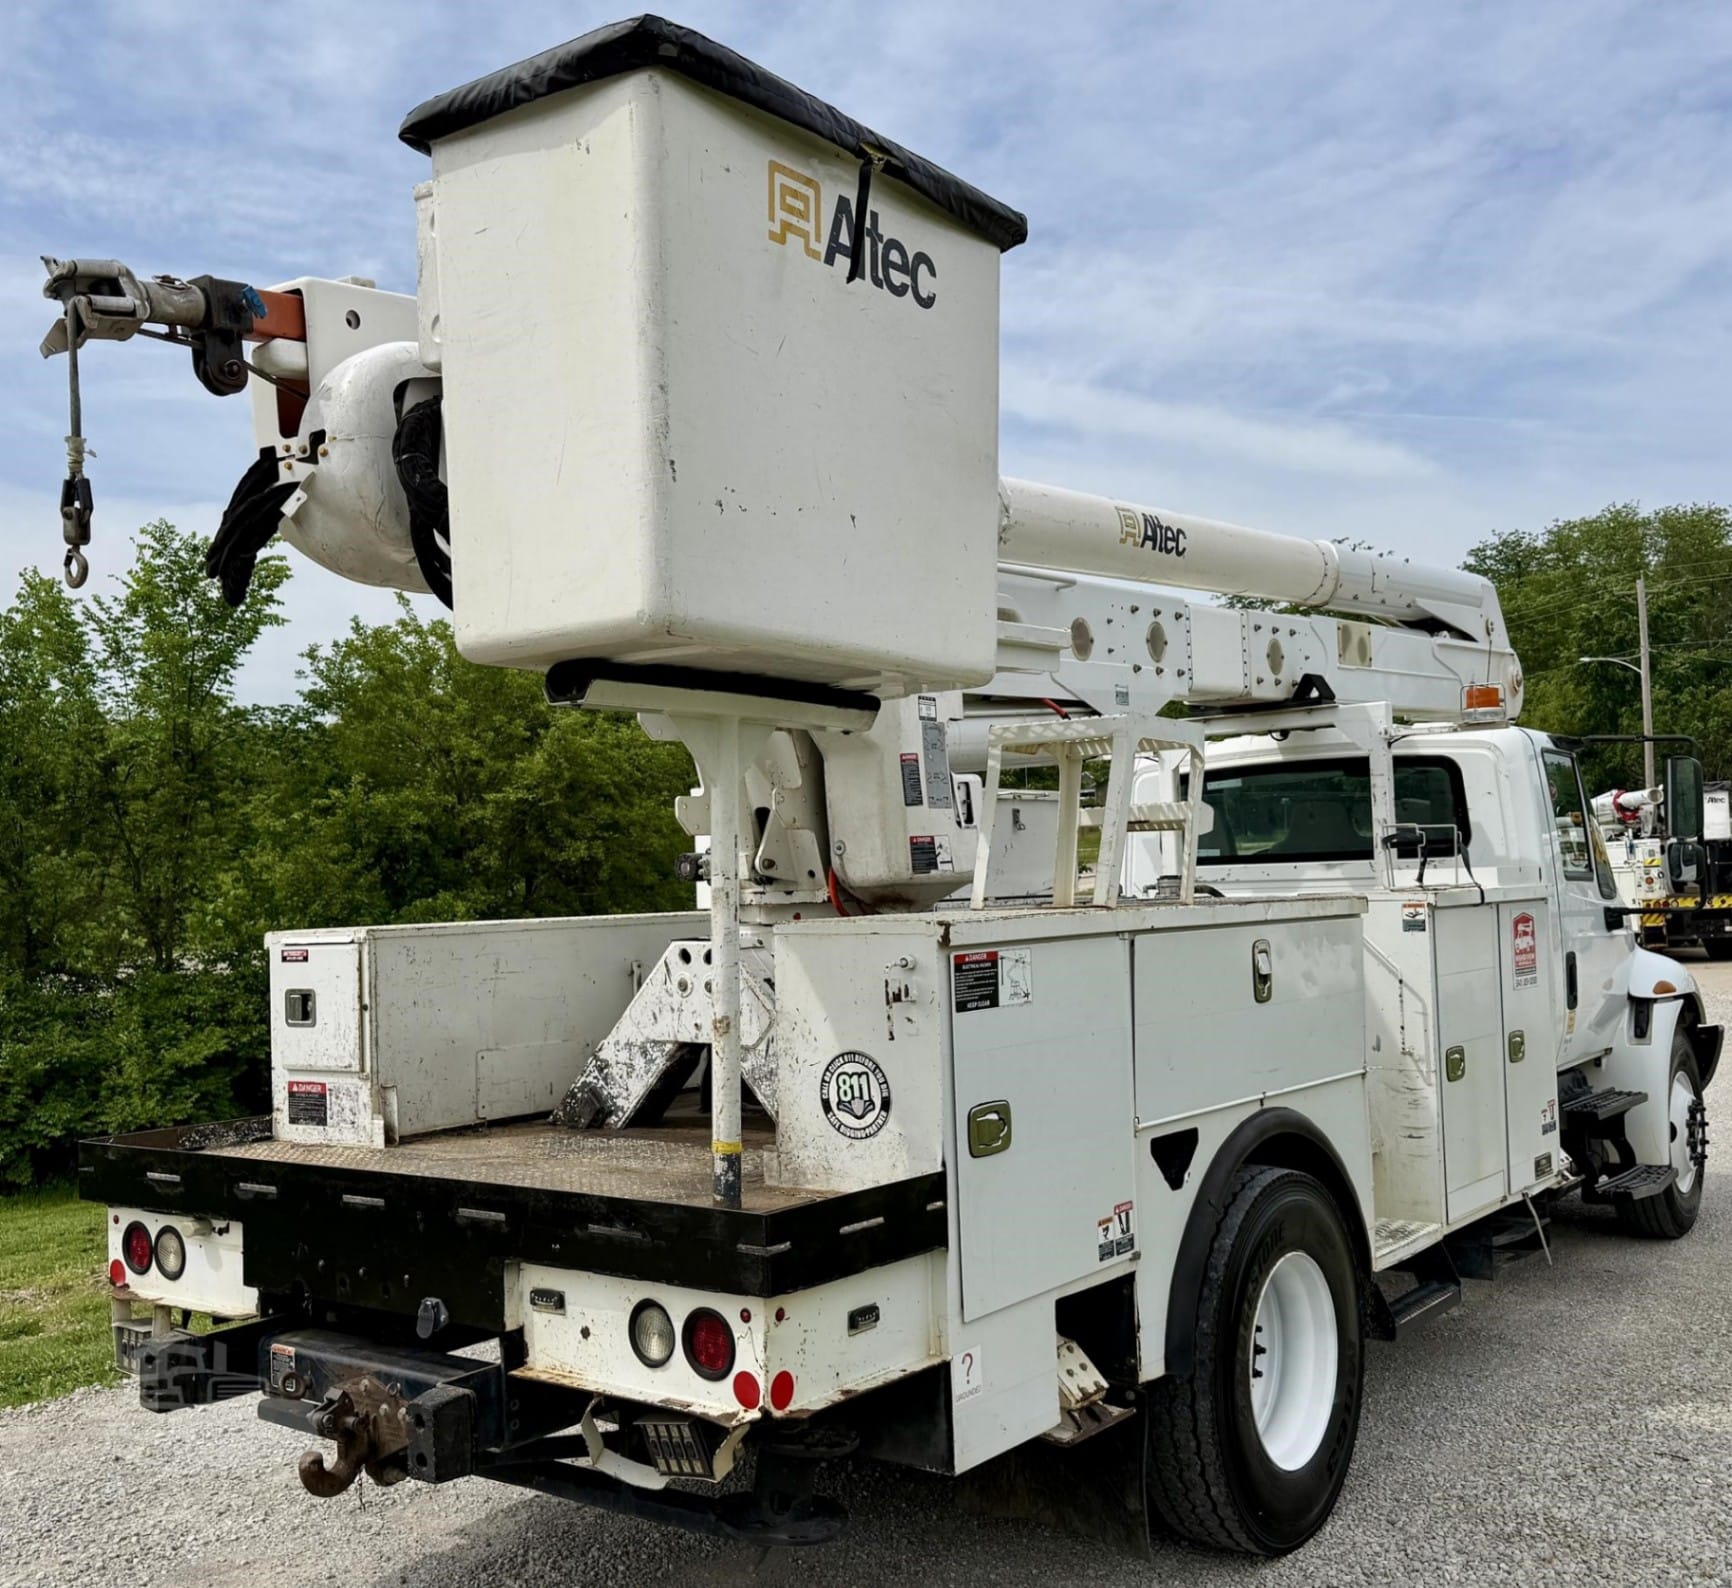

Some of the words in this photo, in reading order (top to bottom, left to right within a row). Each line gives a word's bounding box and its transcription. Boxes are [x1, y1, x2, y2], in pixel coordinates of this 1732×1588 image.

[1141, 512, 1187, 557] Altec
[298, 1083, 322, 1093] DANGER
[837, 1072, 870, 1102] 811
